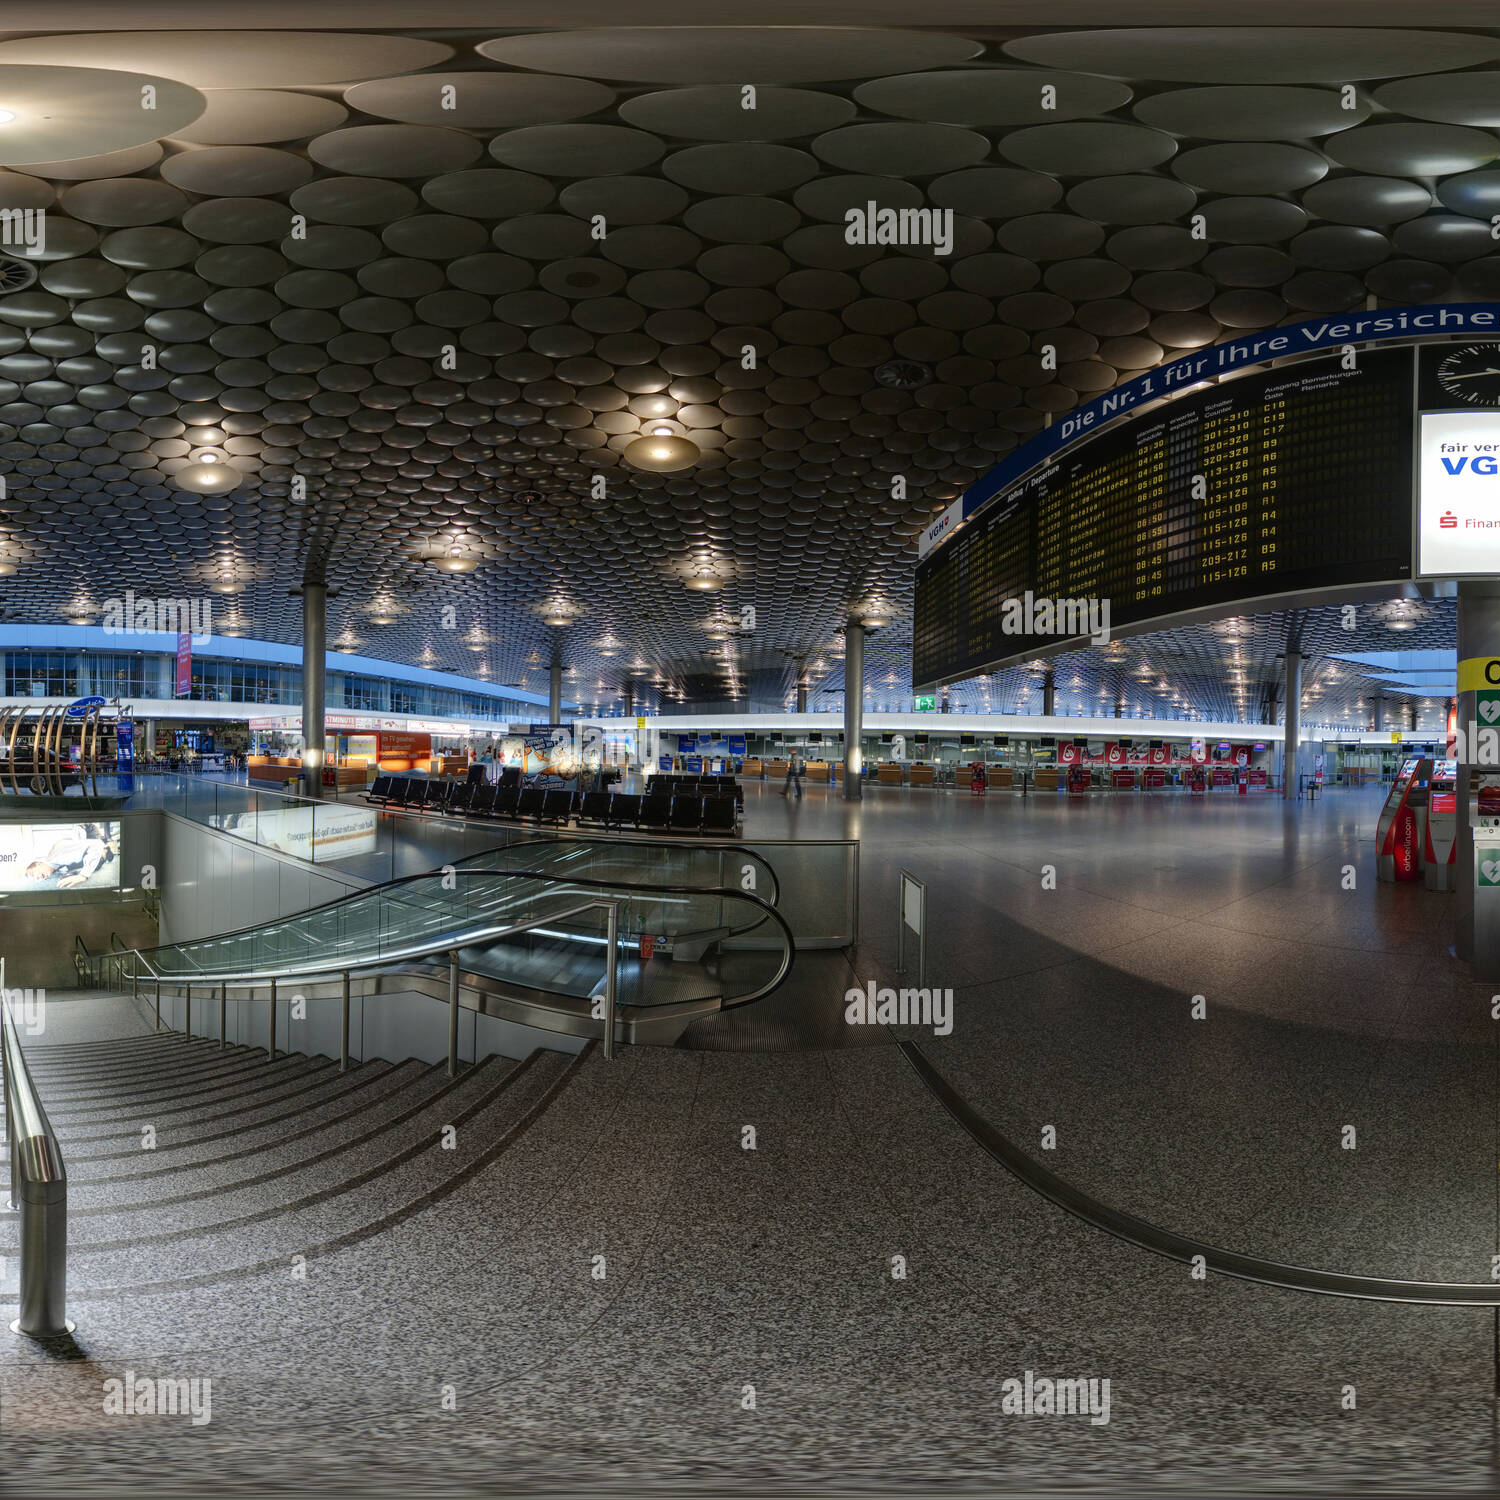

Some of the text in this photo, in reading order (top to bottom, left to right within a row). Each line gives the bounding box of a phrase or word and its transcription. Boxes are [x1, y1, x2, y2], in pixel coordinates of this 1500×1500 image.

[1061, 410, 1094, 439] Die
[1101, 392, 1136, 418] Nr.
[1140, 379, 1154, 397] 1
[1164, 357, 1208, 385] für
[1217, 334, 1287, 366] Ihre
[1264, 370, 1362, 393] Ausgang Bemerkungen
[1264, 380, 1339, 400] Gate Remarks
[1138, 410, 1250, 455] 03:30 301-310
[1204, 406, 1232, 419] Counter
[1137, 438, 1278, 491] 05:00 320-328 B9
[1138, 451, 1164, 467] 04:45
[1204, 422, 1249, 442] 301-310
[1138, 424, 1285, 479] 04:50 320-328 C17
[1441, 443, 1469, 453] fair
[1031, 465, 1060, 487] Departure
[1071, 511, 1105, 532] Frankfurt
[1263, 452, 1278, 463] A6
[1262, 466, 1277, 477] A5
[1070, 480, 1277, 557] Zürich A3
[1203, 502, 1248, 521] 105-108
[1262, 496, 1275, 506] A1
[929, 521, 943, 540] VGH
[1069, 511, 1276, 580] Frankfurt 115-126 A4
[1136, 527, 1276, 571] 08:45 115-126 A4
[1136, 544, 1276, 585] 08:45 209-212 B9
[1136, 560, 1276, 601] 09:40 115-126 A5
